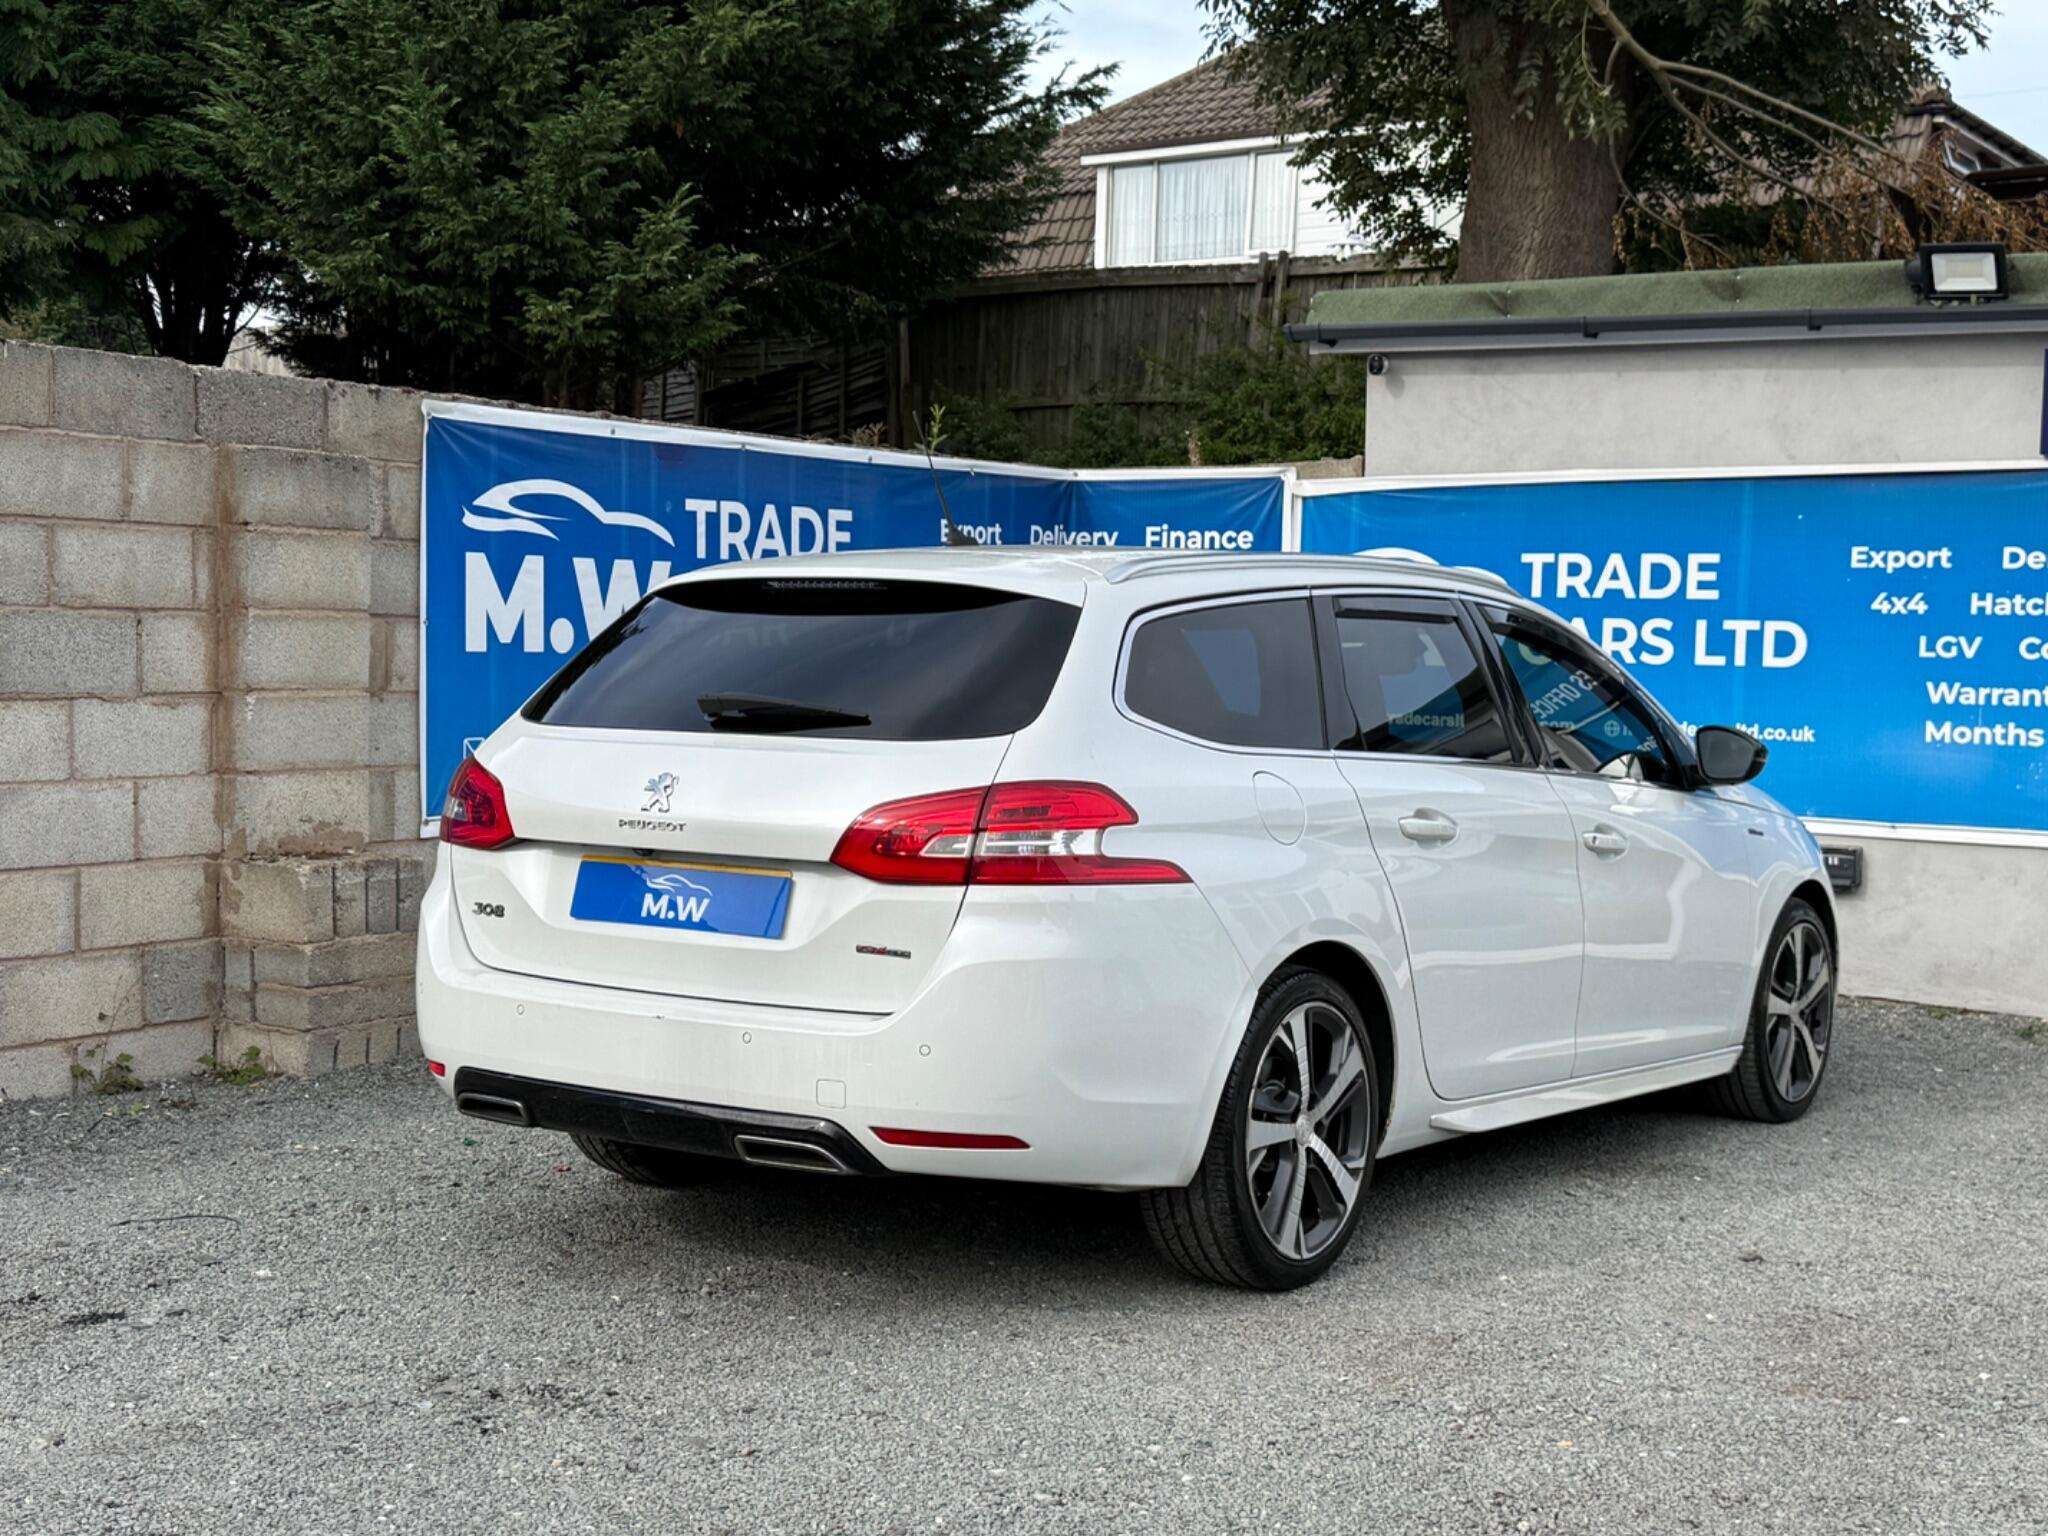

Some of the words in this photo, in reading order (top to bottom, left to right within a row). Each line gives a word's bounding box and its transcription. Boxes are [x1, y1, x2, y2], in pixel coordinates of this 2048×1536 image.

[685, 498, 853, 560] TRADE
[1030, 524, 1119, 546] Delivery
[1145, 523, 1254, 549] Finance
[1850, 546, 1952, 573] Export
[2002, 546, 2048, 570] De
[1521, 552, 1721, 600] TRADE
[1870, 592, 1929, 615] 4x4
[1970, 592, 2048, 616] Hatc
[1694, 619, 1808, 668] LTD
[1919, 635, 1982, 659] LGV
[1925, 720, 2045, 747] Months
[618, 818, 687, 832] PEUGEOT
[472, 901, 505, 918] 308
[640, 893, 711, 923] M.W
